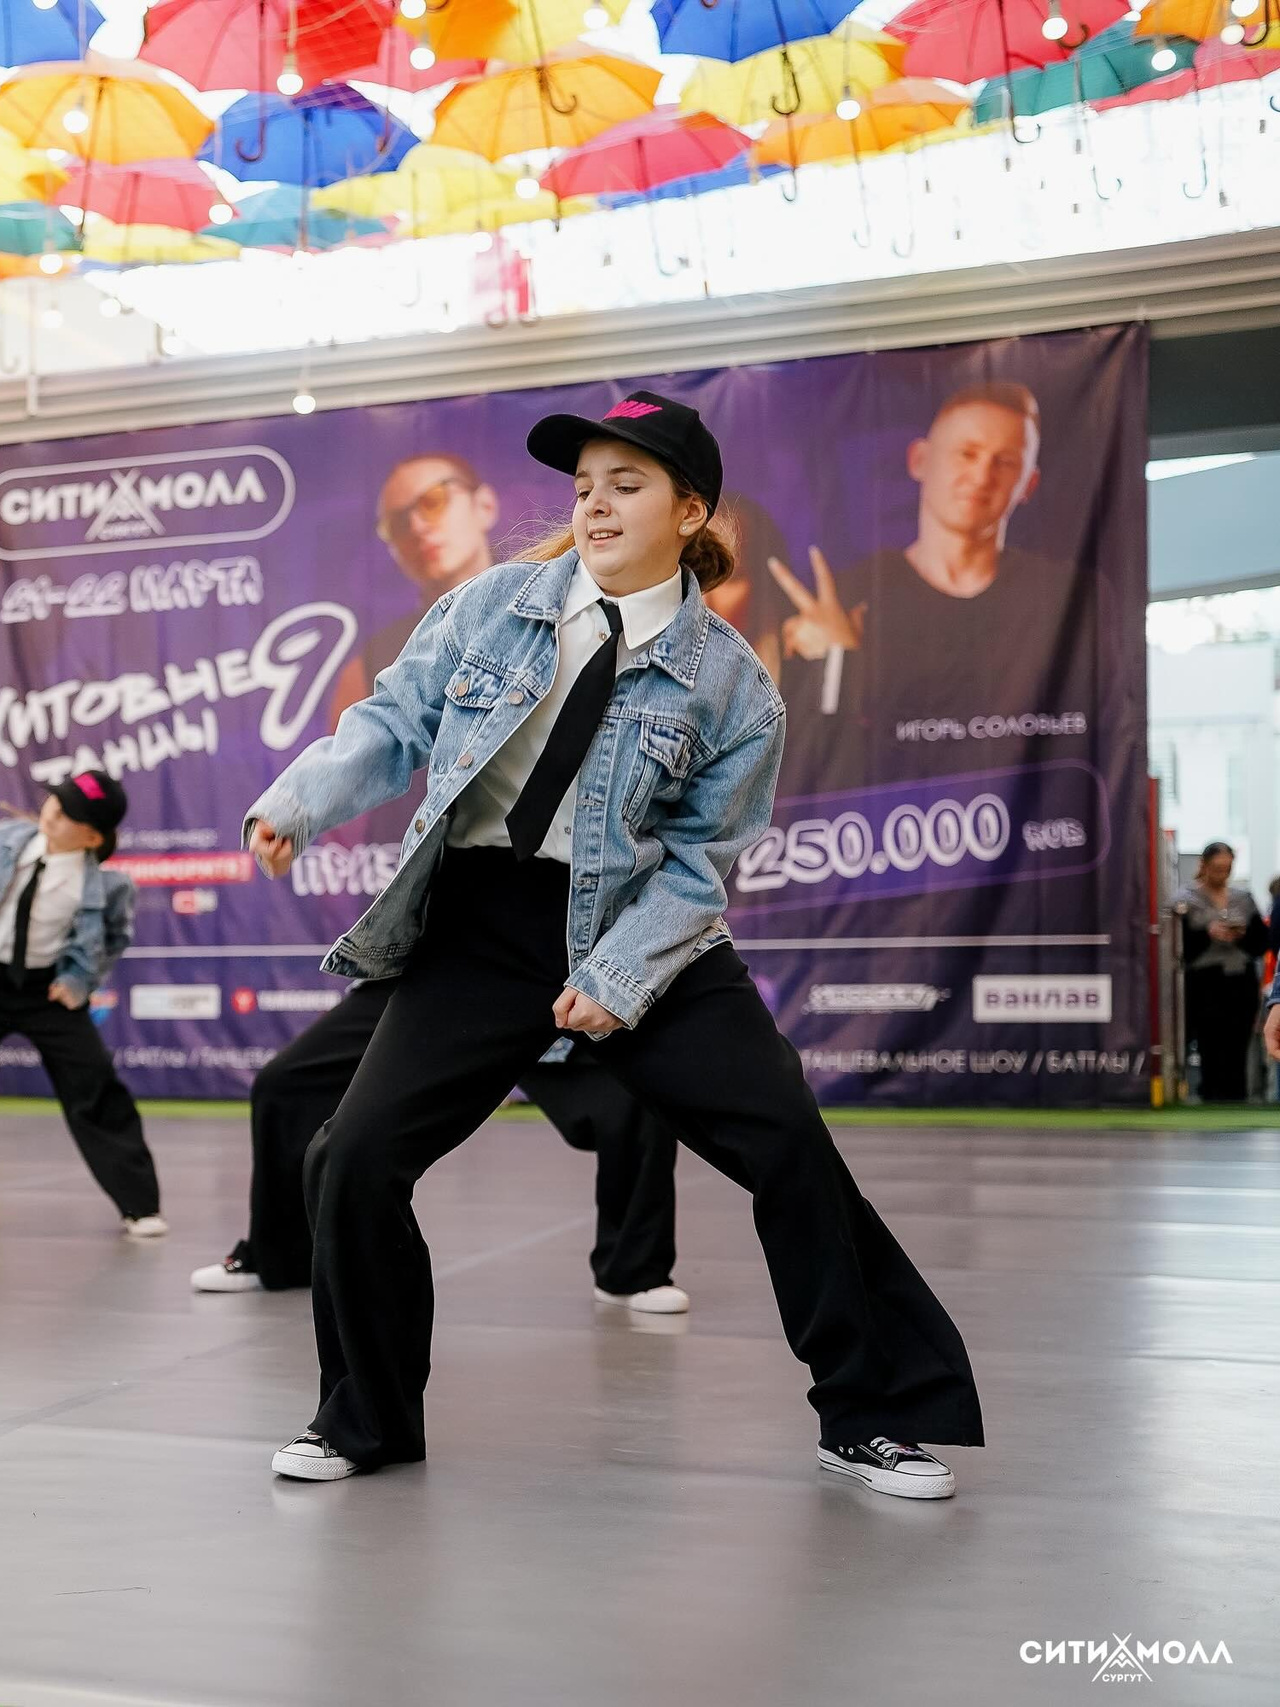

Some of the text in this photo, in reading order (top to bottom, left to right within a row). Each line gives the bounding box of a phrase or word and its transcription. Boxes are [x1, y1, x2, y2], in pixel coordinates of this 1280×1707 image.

[129, 555, 264, 614] МАРТА
[29, 706, 219, 786] ТАНЦЫ
[896, 711, 1087, 742] ИГОРЬ СОЛОВЬЕВ
[734, 793, 1010, 894] 250.000
[970, 1050, 1028, 1074] ШОУ
